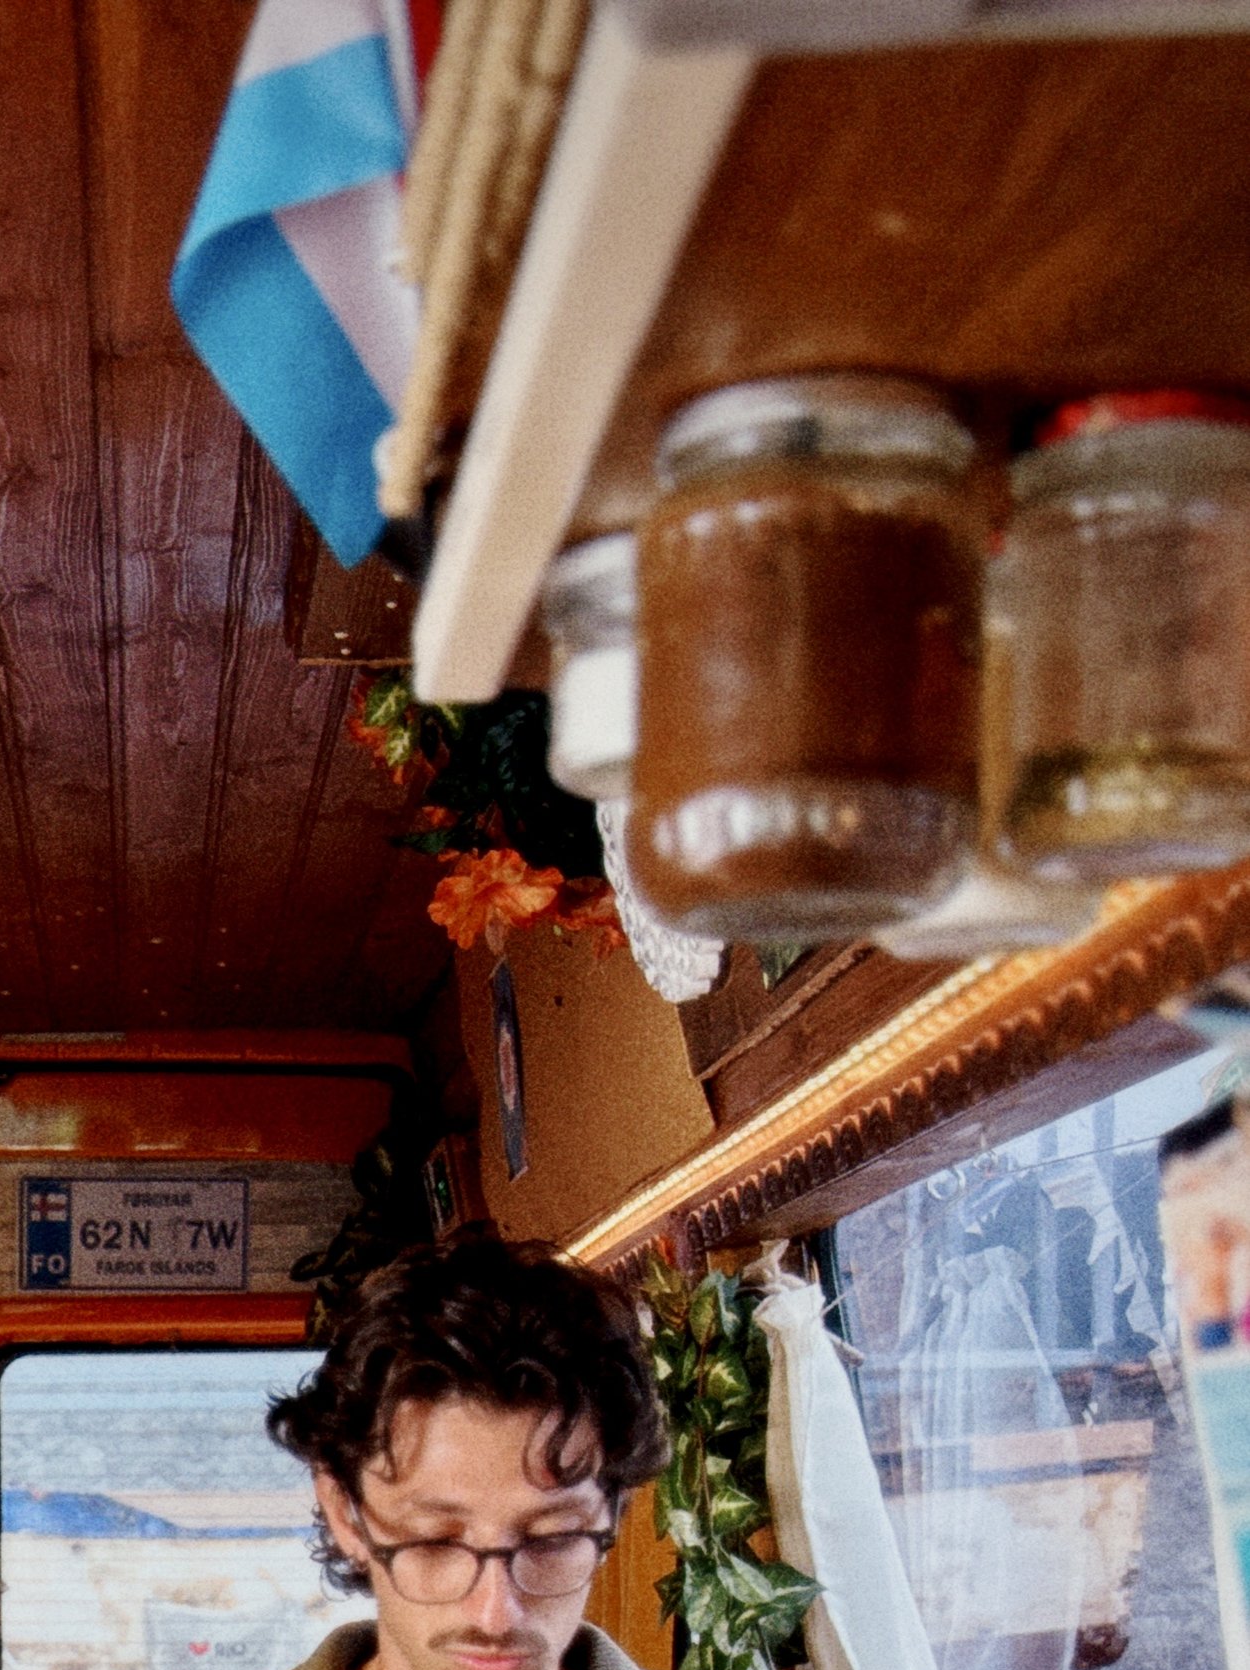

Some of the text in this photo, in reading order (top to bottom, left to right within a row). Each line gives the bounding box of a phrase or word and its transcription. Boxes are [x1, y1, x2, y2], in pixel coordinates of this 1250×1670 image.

[80, 1219, 239, 1251] 62N 7W
[31, 1254, 66, 1275] FO
